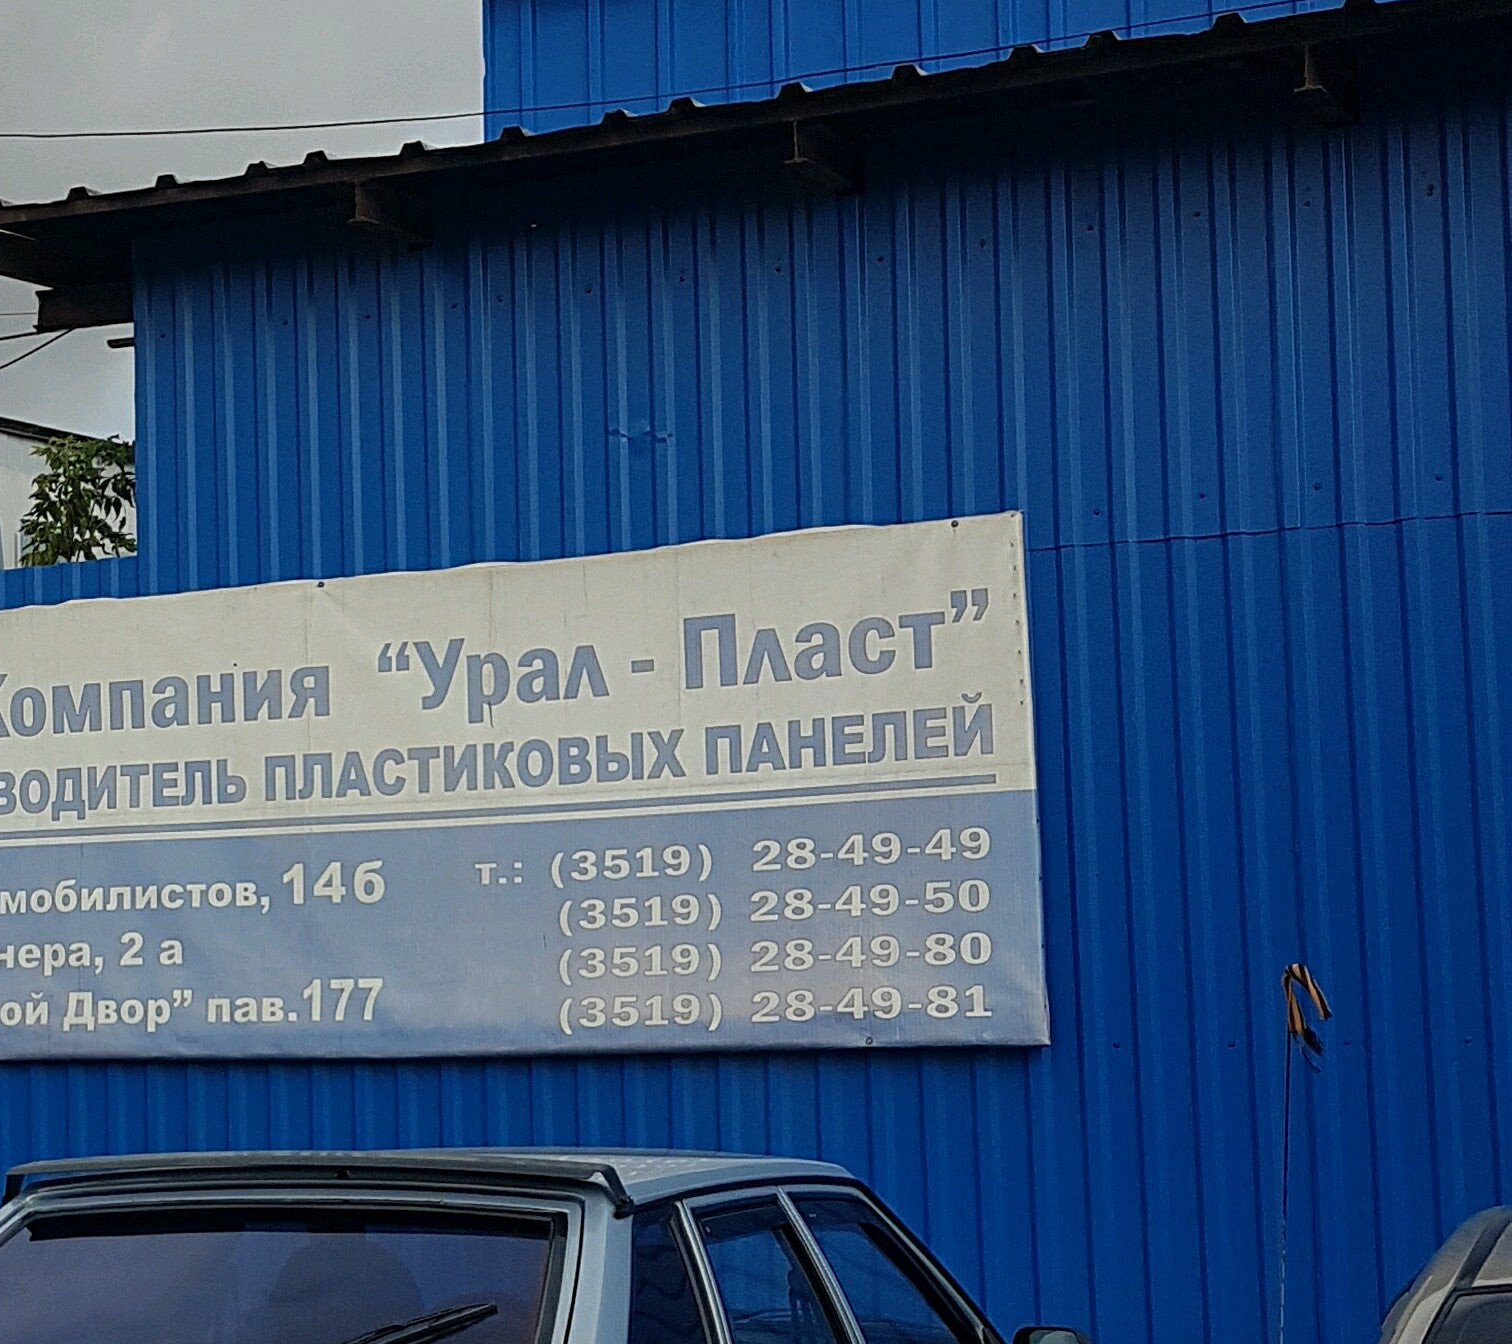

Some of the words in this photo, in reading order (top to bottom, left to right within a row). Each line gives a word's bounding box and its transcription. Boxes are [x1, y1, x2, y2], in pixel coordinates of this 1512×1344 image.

[377, 637, 610, 723] “Урал
[683, 587, 989, 689] Пласт”
[265, 727, 686, 803] ПЛАСТИКОВЫХ
[705, 692, 994, 775] ПАНЕЛЕЙ
[549, 843, 714, 889] (3519)
[751, 825, 991, 873] 28-49-49
[557, 893, 723, 937] (3519)
[749, 878, 991, 923] 28-49-50
[119, 931, 145, 968] 2
[158, 940, 184, 966] а
[557, 942, 723, 986] (3519)
[749, 930, 993, 974] 28-49-80
[63, 989, 194, 1033] Двор”
[558, 993, 724, 1036] (3519)
[750, 984, 994, 1025] 28-49-81
